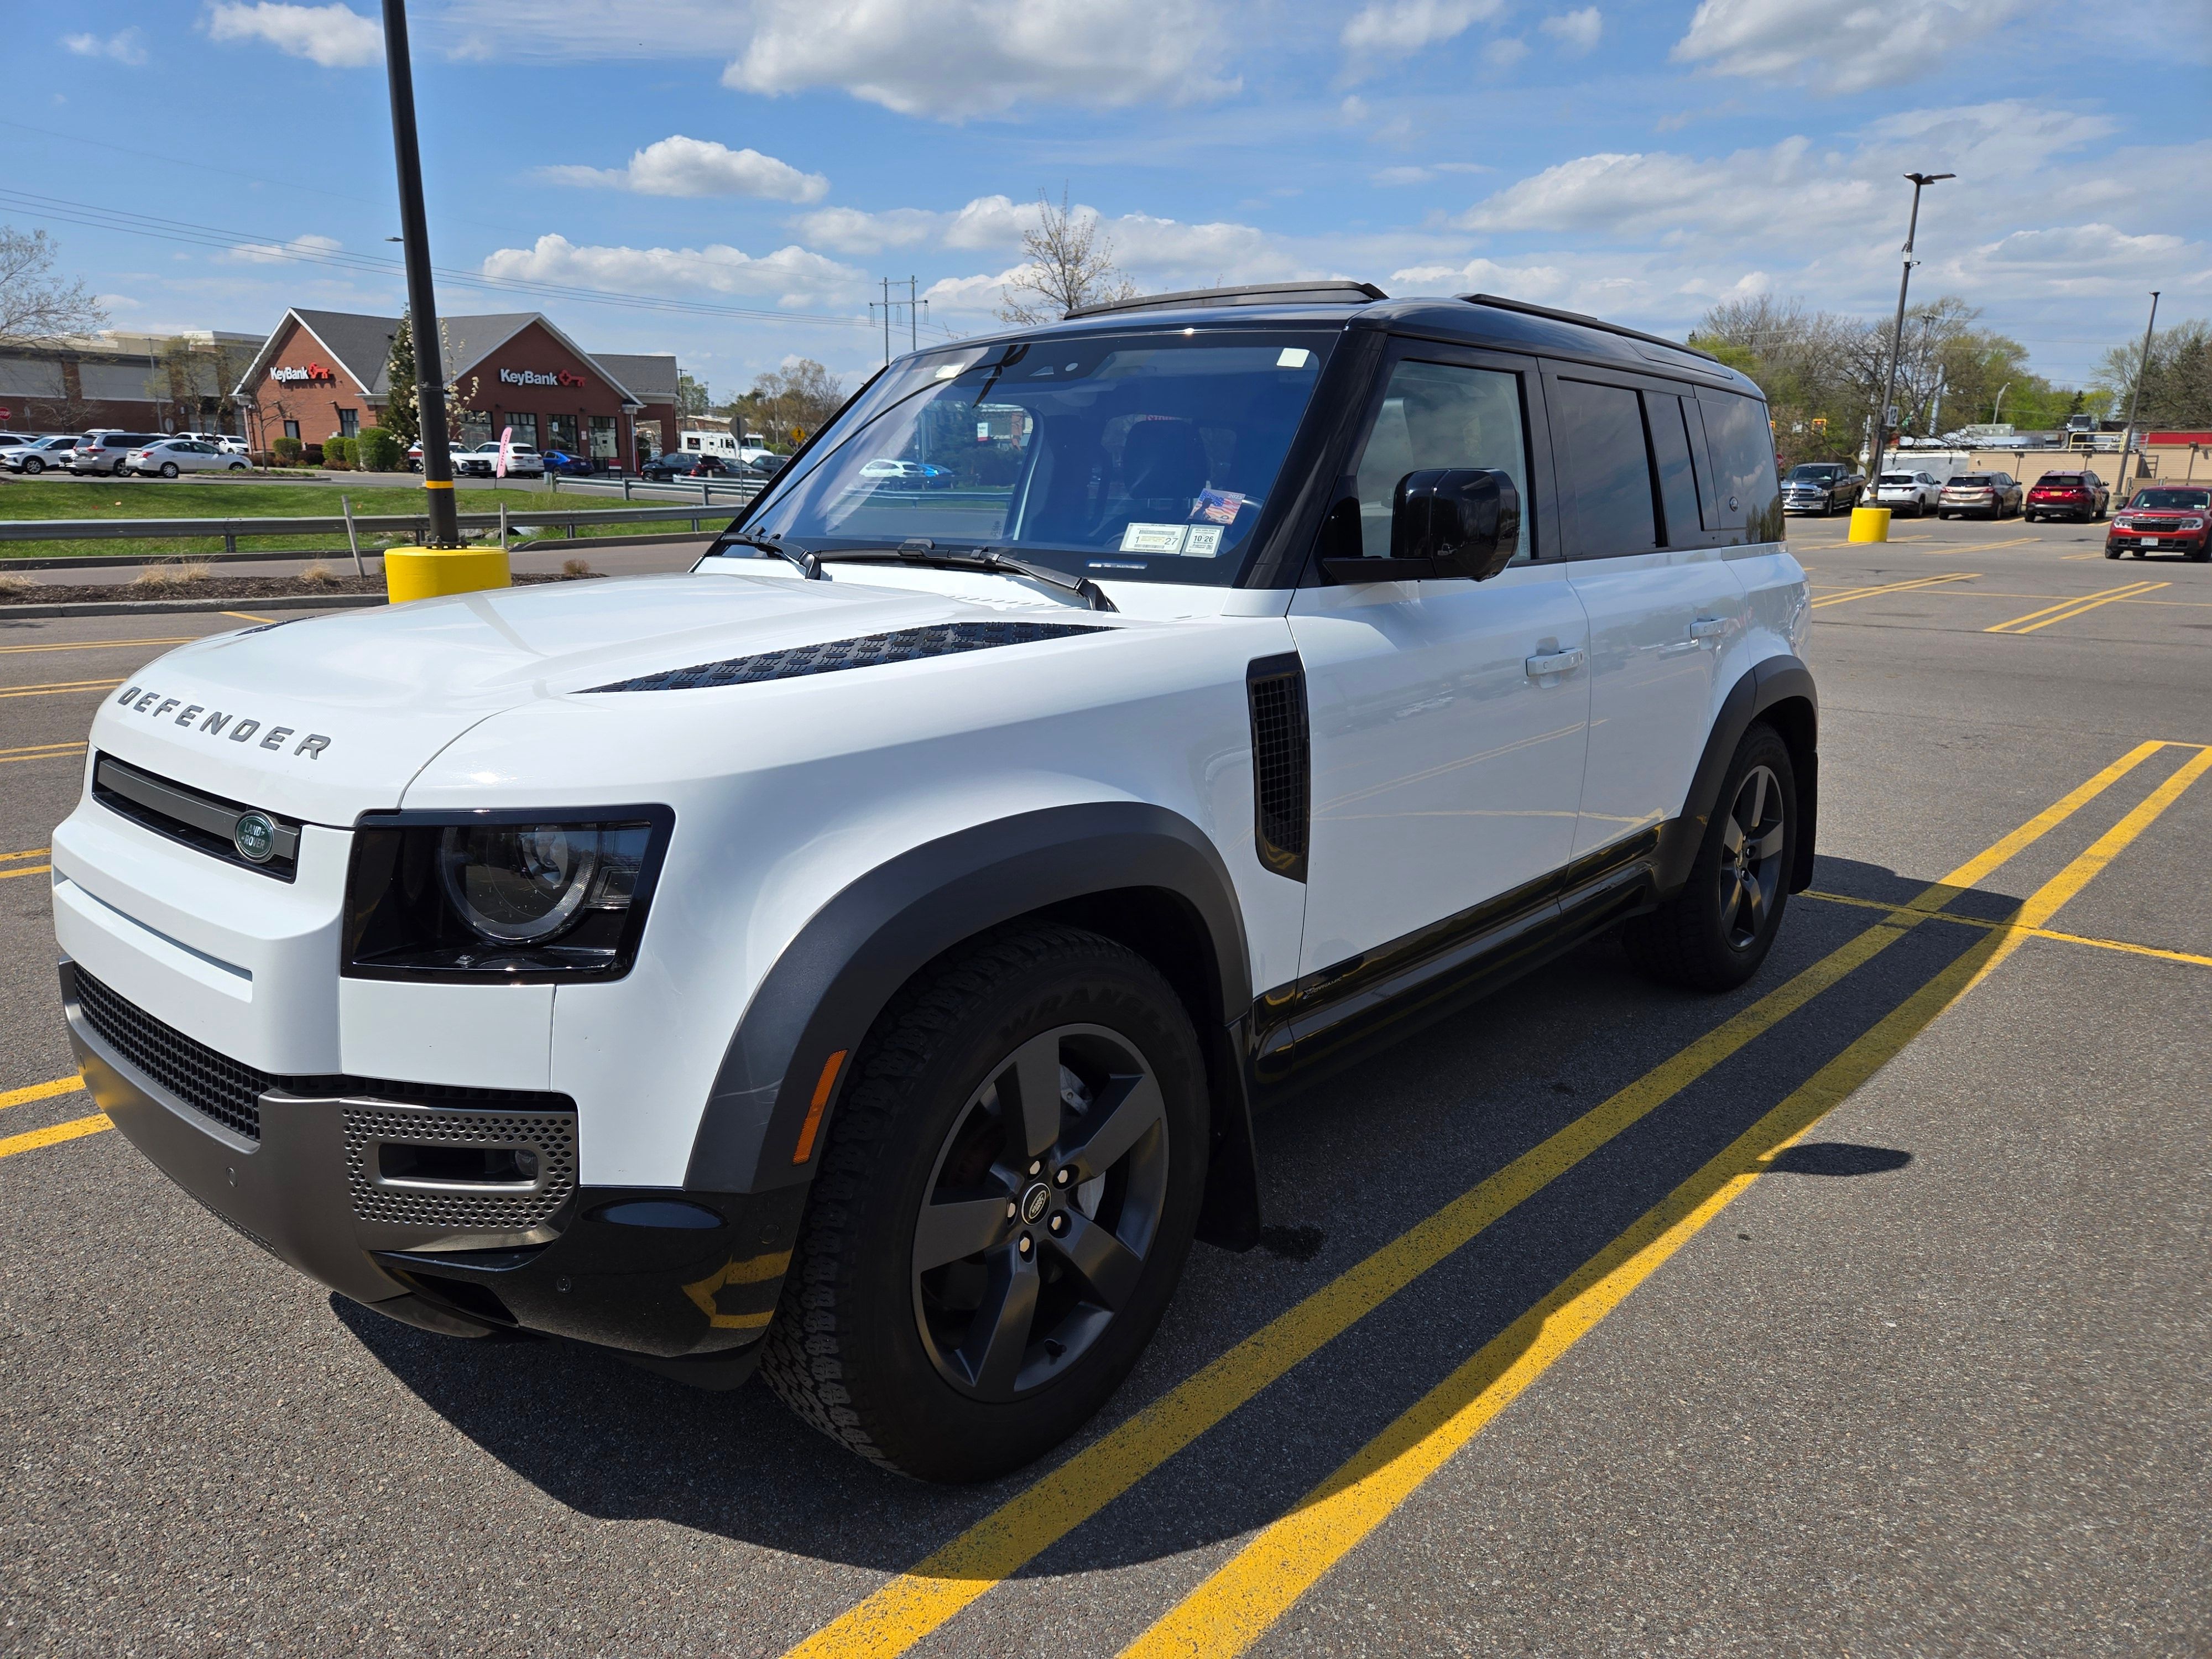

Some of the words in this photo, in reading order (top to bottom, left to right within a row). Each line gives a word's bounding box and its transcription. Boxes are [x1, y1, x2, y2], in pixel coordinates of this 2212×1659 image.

[270, 366, 310, 382] KeyBank
[500, 368, 559, 385] KeyBank
[117, 686, 331, 760] DEFENDER
[244, 822, 262, 836] LAND
[244, 834, 265, 849] ROVER
